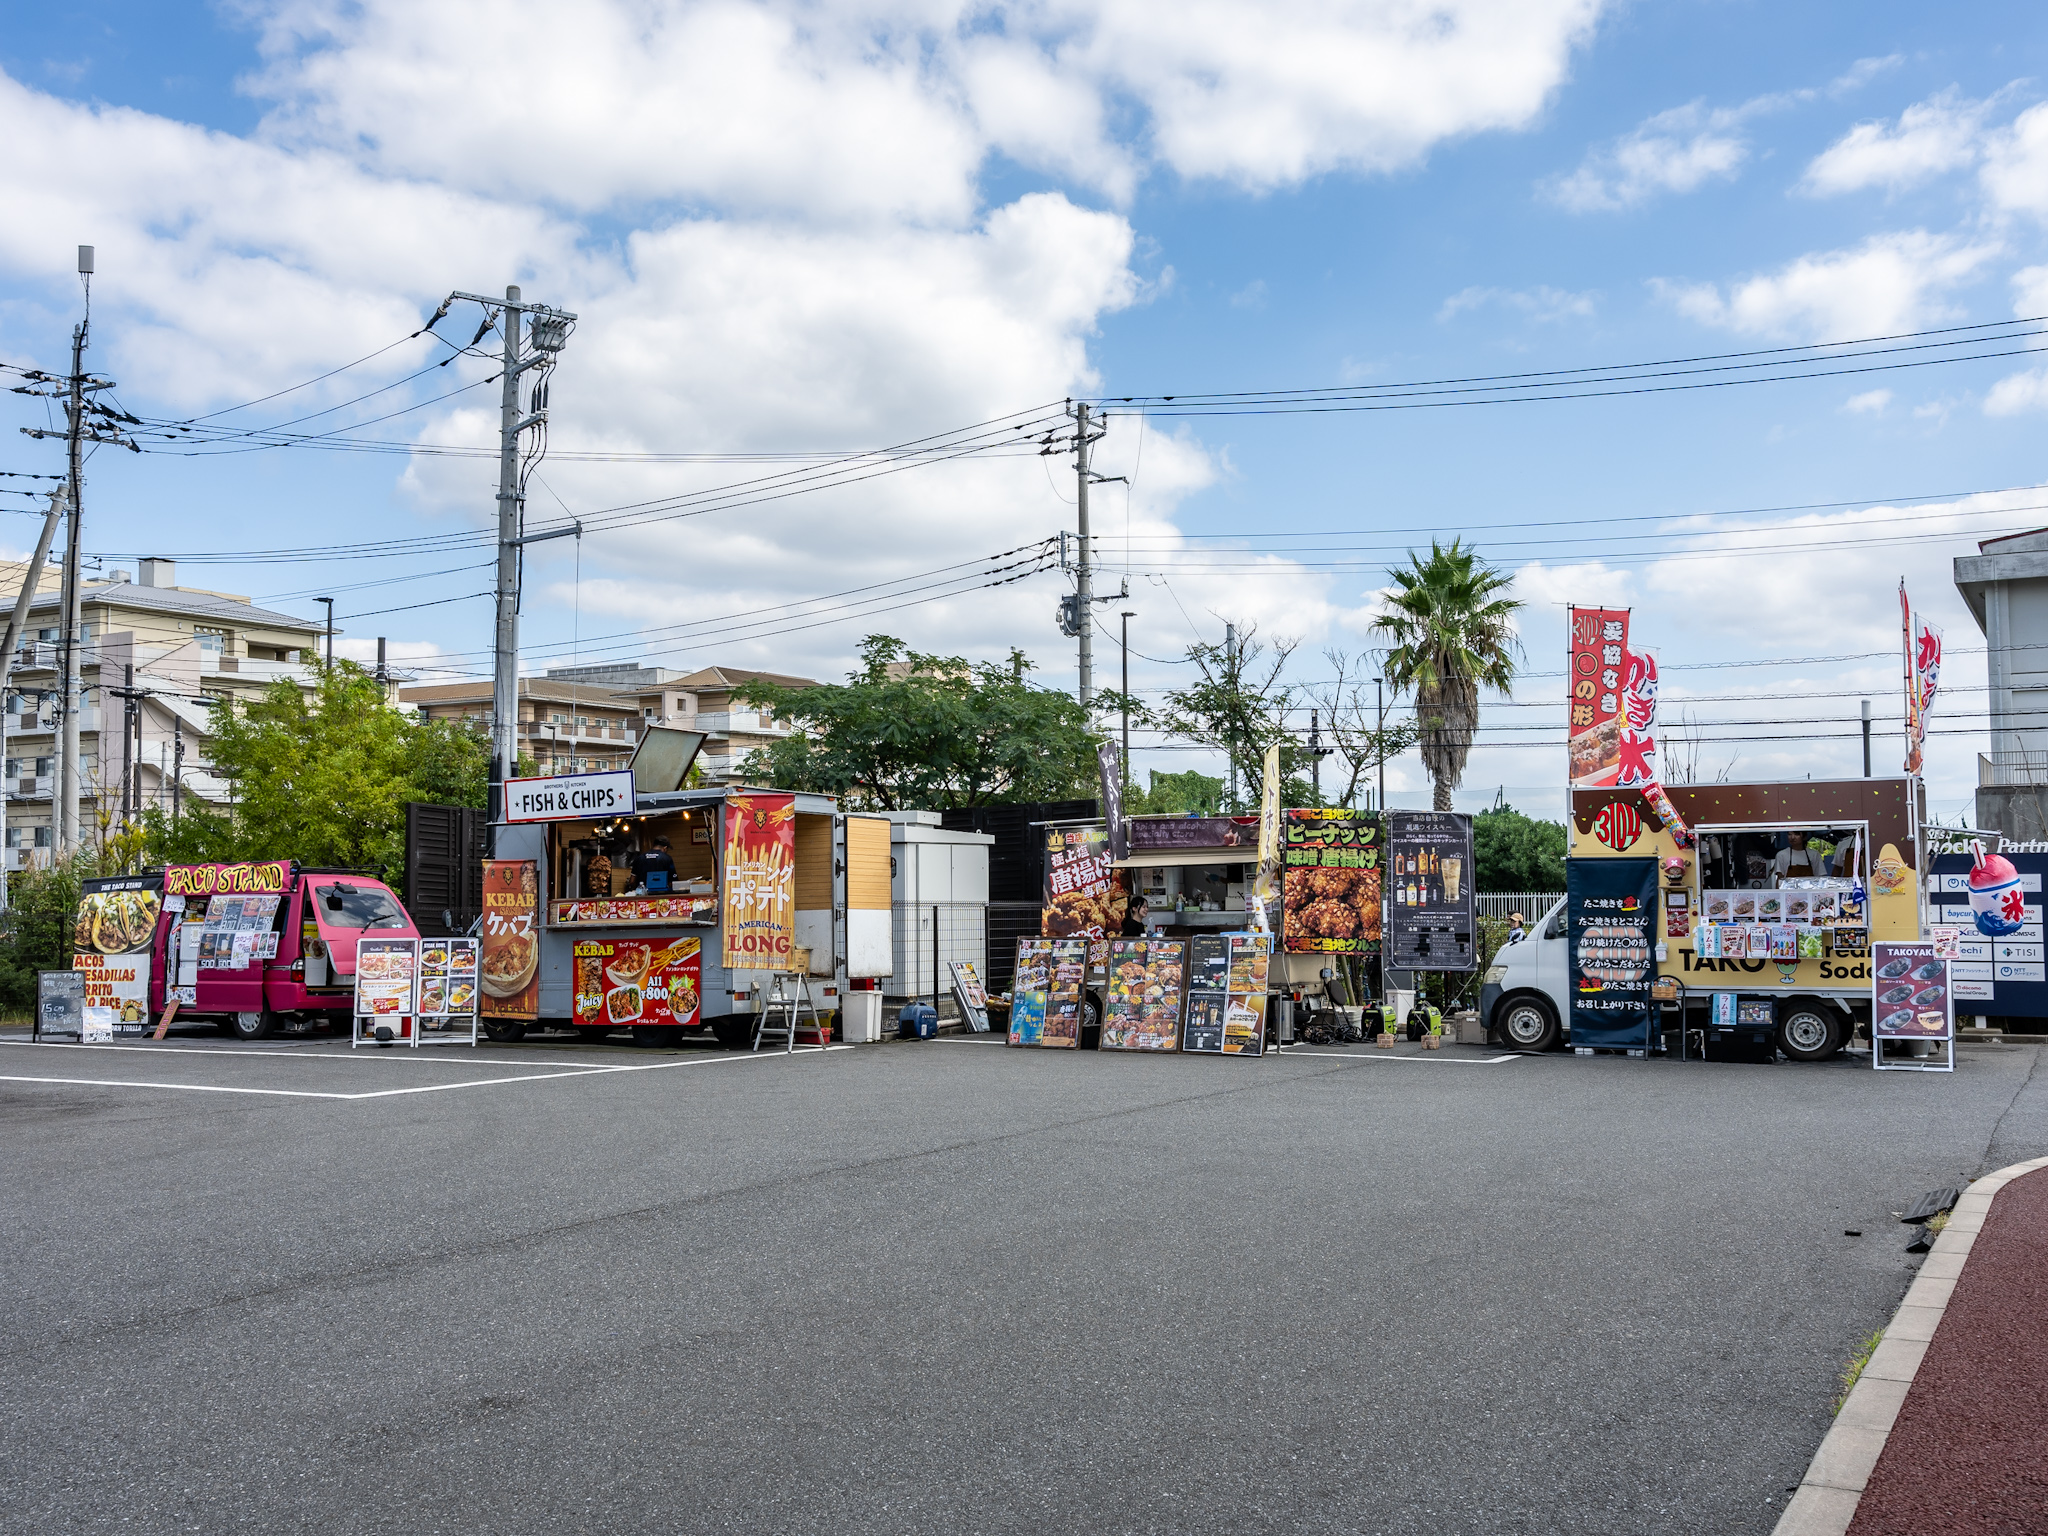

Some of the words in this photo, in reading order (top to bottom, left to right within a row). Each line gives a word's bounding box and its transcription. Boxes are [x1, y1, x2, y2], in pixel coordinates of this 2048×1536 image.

[522, 793, 554, 813] FISH
[558, 792, 569, 810] &
[571, 788, 615, 809] CHIPS
[1135, 822, 1157, 831] Spice
[1159, 821, 1175, 830] and
[1178, 821, 1210, 830] alcohol
[1595, 802, 1642, 849] 3104
[1066, 832, 1108, 844] 当店人気N
[1135, 830, 1170, 838] specialty
[1287, 823, 1376, 845] ピーナッツ
[743, 861, 766, 869] アメリカン
[1286, 848, 1319, 866] 味噌
[1320, 847, 1379, 870] 唐揚げ
[168, 866, 216, 894] TACO
[217, 863, 284, 893] STAND
[486, 893, 535, 907] KEBAB
[730, 879, 791, 912] ポテト
[1583, 896, 1642, 909] たこ焼きを愛し
[2001, 889, 2025, 923] 氷
[487, 911, 535, 937] ケバブ
[738, 920, 783, 932] AMERICAN
[1578, 917, 1649, 926] たこ焼きをとことん
[728, 934, 791, 954] LONG
[574, 945, 615, 957] KEBAB
[1887, 948, 1933, 956] TAKOYAK
[74, 955, 105, 967] ACOS
[1578, 959, 1651, 969] ダシからこだわった
[86, 969, 136, 981] ESADILLAS
[647, 976, 662, 987] All
[86, 983, 113, 996] RRITO
[1578, 977, 1650, 991] 本気のたこ焼きを
[640, 987, 669, 1000] ¥800
[41, 1003, 52, 1012] 15
[100, 997, 121, 1009] RICE
[576, 994, 603, 1014] Juicy
